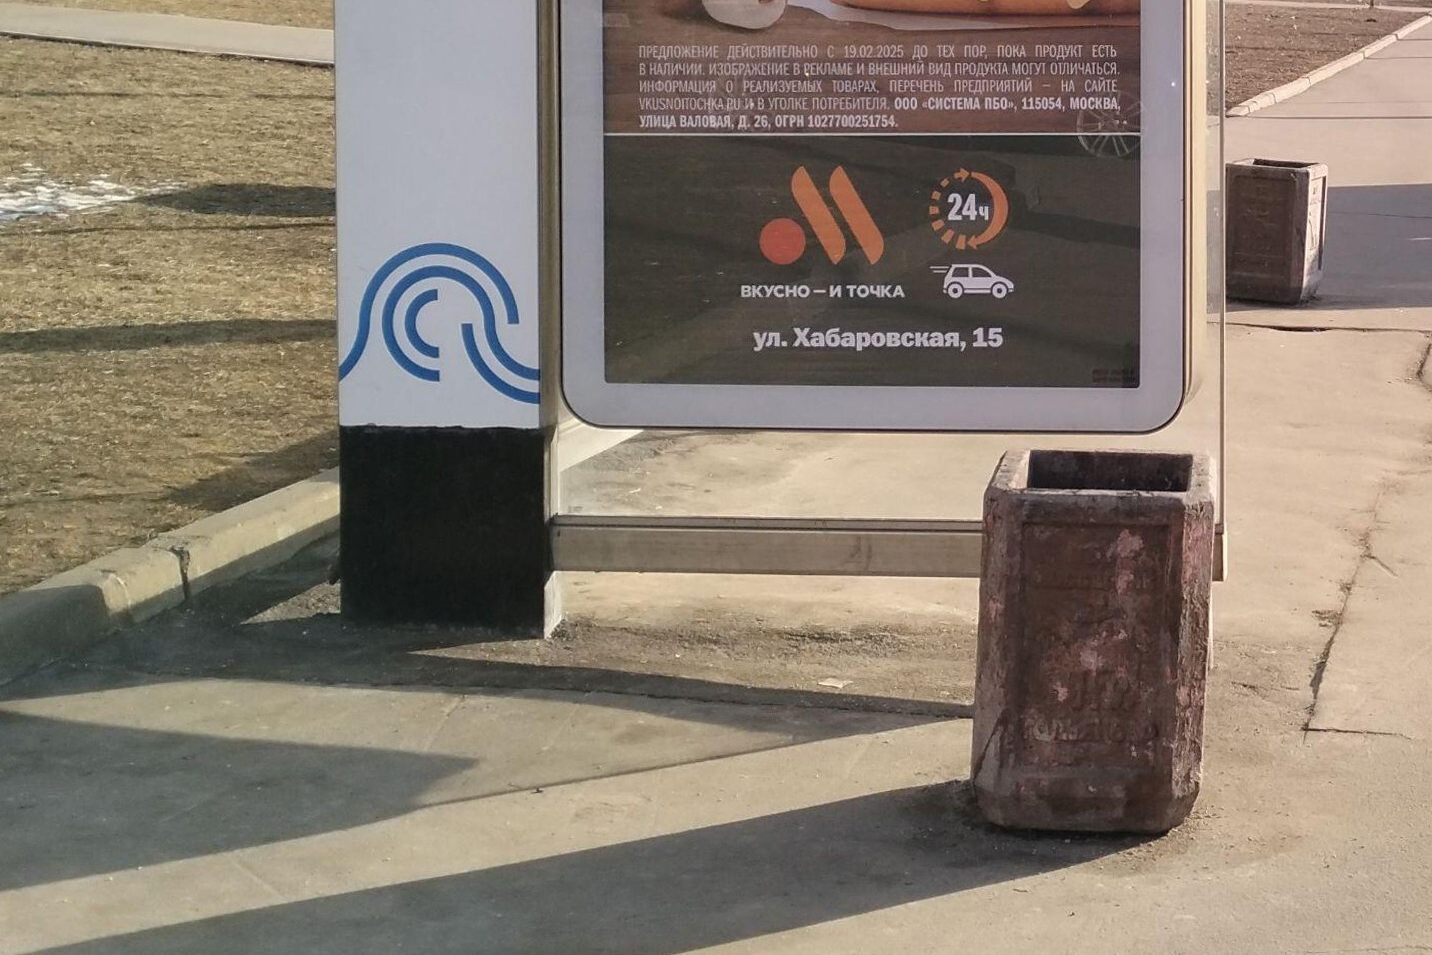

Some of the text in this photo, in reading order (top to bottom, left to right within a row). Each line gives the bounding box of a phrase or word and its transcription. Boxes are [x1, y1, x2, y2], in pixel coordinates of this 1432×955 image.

[638, 43, 1117, 60] ПРЕДЛОЖЕНИЕ ДЕЙСТВИТЕЛЬНО С 19.02.2025 ДО ТЕХ ПОР, ПОКА ПРОДУКТ ЕСТЬ
[639, 61, 1120, 77] В НАЛИЧИИ. ИЗОБРАЖЕНИЕ В РЕКЛАМЕ И ВНЕШНИЙ ВИД ПРОДУКТА МОГУТ ОТЛИЧАТЬСЯ.
[639, 80, 716, 94] ИНФОРМАЦИЯ
[726, 81, 733, 94] О
[743, 80, 822, 93] РЕАЛИЗУЕМЫХ
[832, 80, 880, 94] ТОВАРАХ,
[889, 80, 944, 93] ПЕРЕЧЕНЬ
[954, 78, 1032, 94] ПРЕДПРИЯТИЙ
[1061, 79, 1075, 92] НА
[1085, 78, 1118, 92] САЙТЕ
[757, 98, 765, 110] В
[768, 98, 809, 110] УГОЛКЕ
[812, 98, 890, 110] ПОТРЕБИТЕЛЯ.
[894, 98, 918, 110] ООО
[922, 98, 981, 110] «СИСТЕМА
[984, 98, 1018, 112] ПБО»,
[1022, 98, 1065, 112] 115054,
[1069, 97, 1121, 111] МОСКВА,
[639, 115, 899, 129] УЛИЦА ВАЛОВАЯ, Д. 26, ОГРН 1027700251754.
[947, 193, 989, 221] 24ч
[740, 285, 810, 298] ВКУСНО
[829, 285, 842, 298] И
[847, 285, 905, 298] ТОЧКА
[753, 327, 1003, 351] ул. Хабаровская, 15
